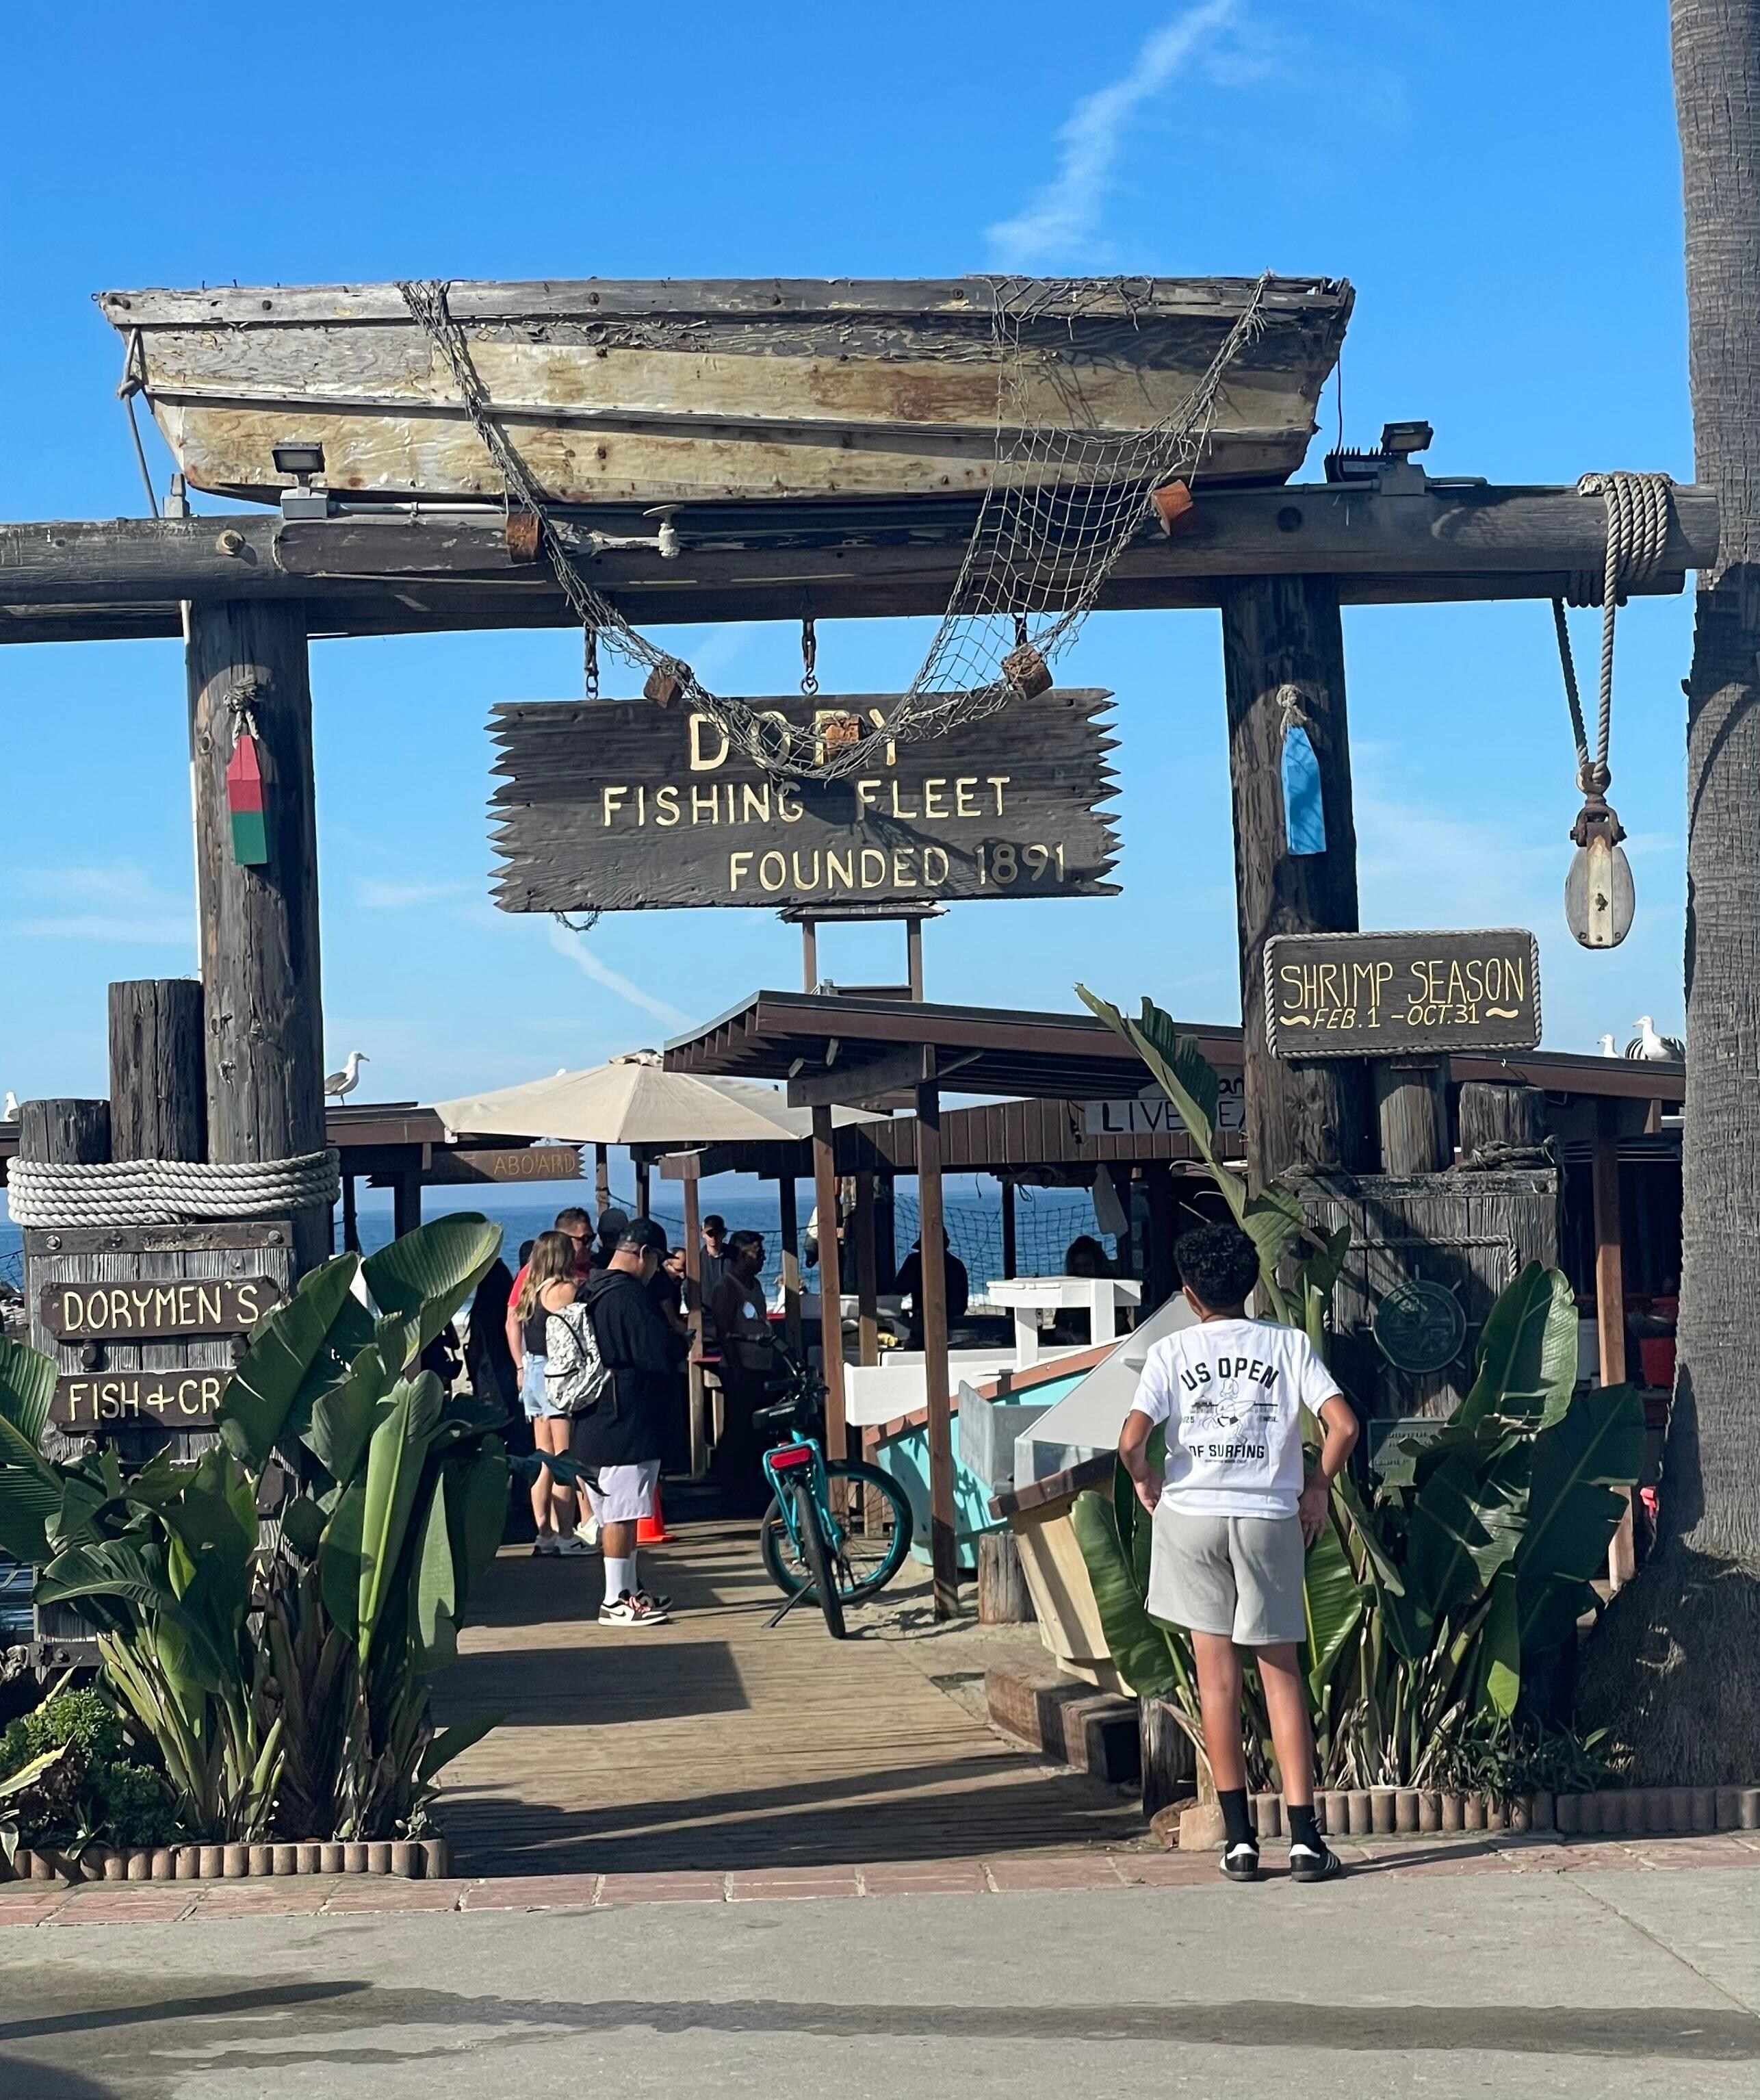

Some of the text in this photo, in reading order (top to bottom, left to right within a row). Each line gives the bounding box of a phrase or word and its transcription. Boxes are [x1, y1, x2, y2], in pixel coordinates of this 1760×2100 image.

[603, 776, 1011, 827] FISHING FLEET
[730, 843, 1065, 892] FOUNDED 1891
[1280, 958, 1524, 1010] SHRIMP SEASON
[1312, 1008, 1363, 1029] FEB.
[1102, 1101, 1187, 1131] LIVE
[64, 1281, 259, 1331] DORYMEN'S
[1180, 1357, 1279, 1391] US OPEN
[69, 1380, 140, 1421] FISH
[179, 1377, 233, 1416] CR
[1209, 1444, 1265, 1459] SURFING
